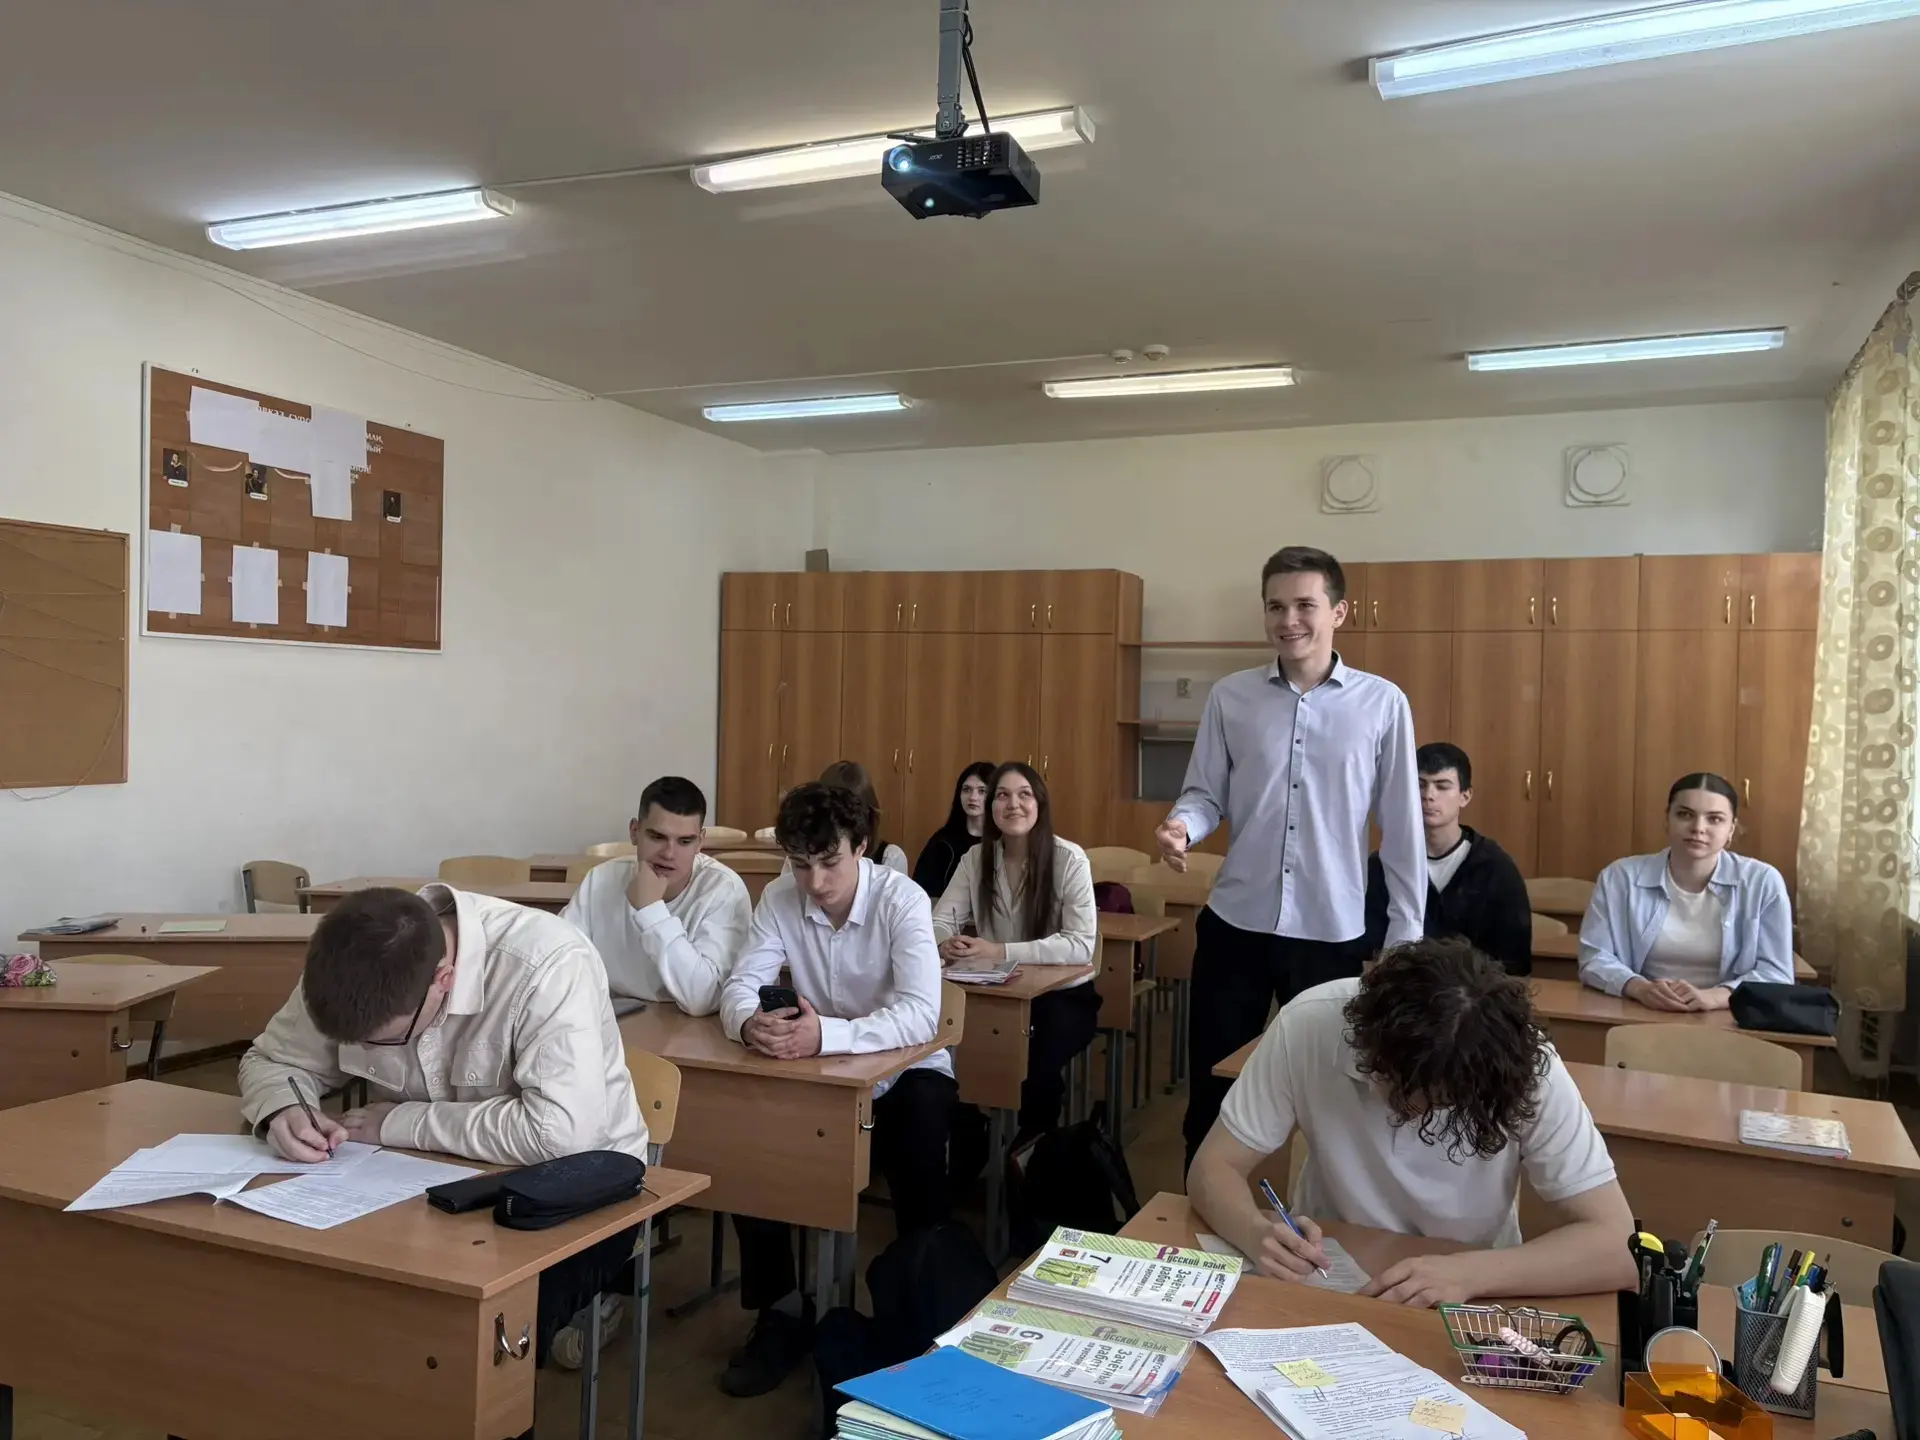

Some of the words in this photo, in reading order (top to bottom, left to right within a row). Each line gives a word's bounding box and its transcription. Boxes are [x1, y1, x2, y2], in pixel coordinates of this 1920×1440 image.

[1089, 1253, 1112, 1263] 7
[1156, 1246, 1200, 1265] Русский
[1201, 1260, 1227, 1270] язык
[1149, 1265, 1174, 1292] работы
[1161, 1268, 1192, 1303] Зачётные
[1016, 1329, 1047, 1341] 6
[1091, 1325, 1140, 1345] Русский
[1140, 1341, 1169, 1351] язык
[1083, 1344, 1115, 1373] работы
[1092, 1348, 1133, 1385] Зачётные
